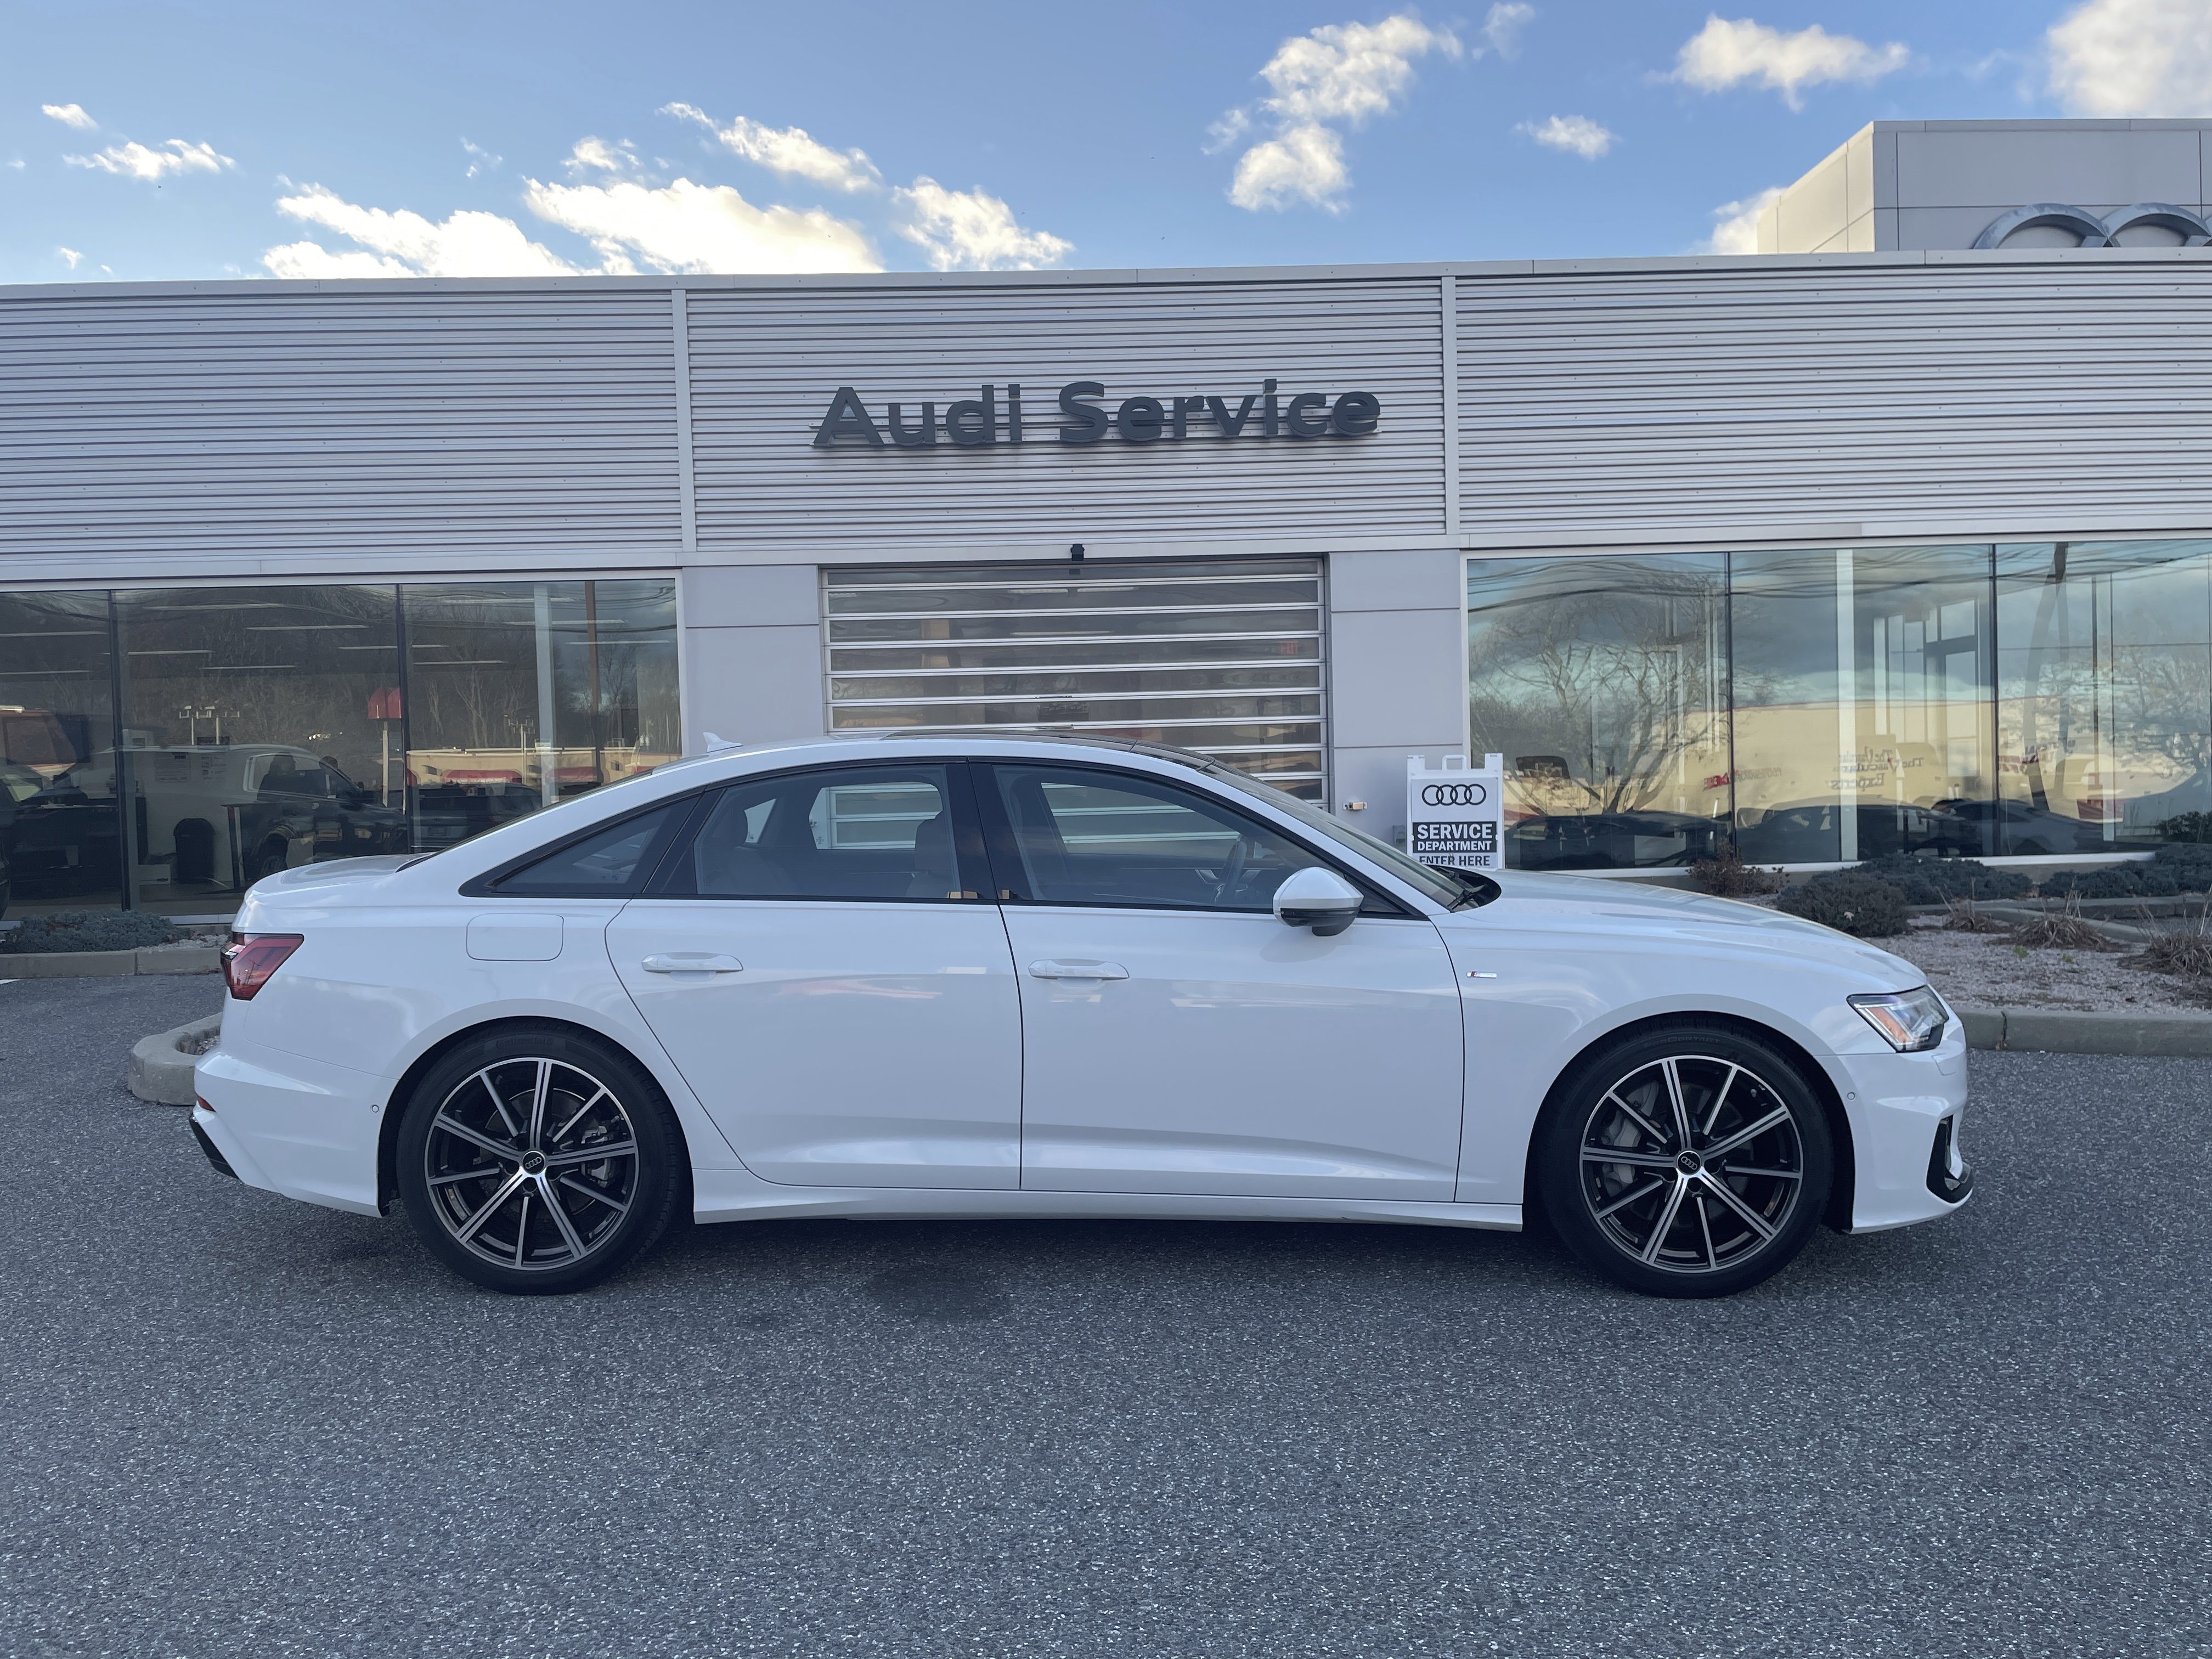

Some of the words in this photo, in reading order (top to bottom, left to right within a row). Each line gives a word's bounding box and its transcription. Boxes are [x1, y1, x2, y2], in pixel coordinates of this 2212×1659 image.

[813, 384, 1022, 447] Audi
[1058, 379, 1381, 441] Service
[1417, 823, 1492, 839] SERVICE
[1417, 840, 1492, 851] DEPARTMENT
[1419, 856, 1455, 865] ENTER
[1459, 855, 1490, 866] HERE
